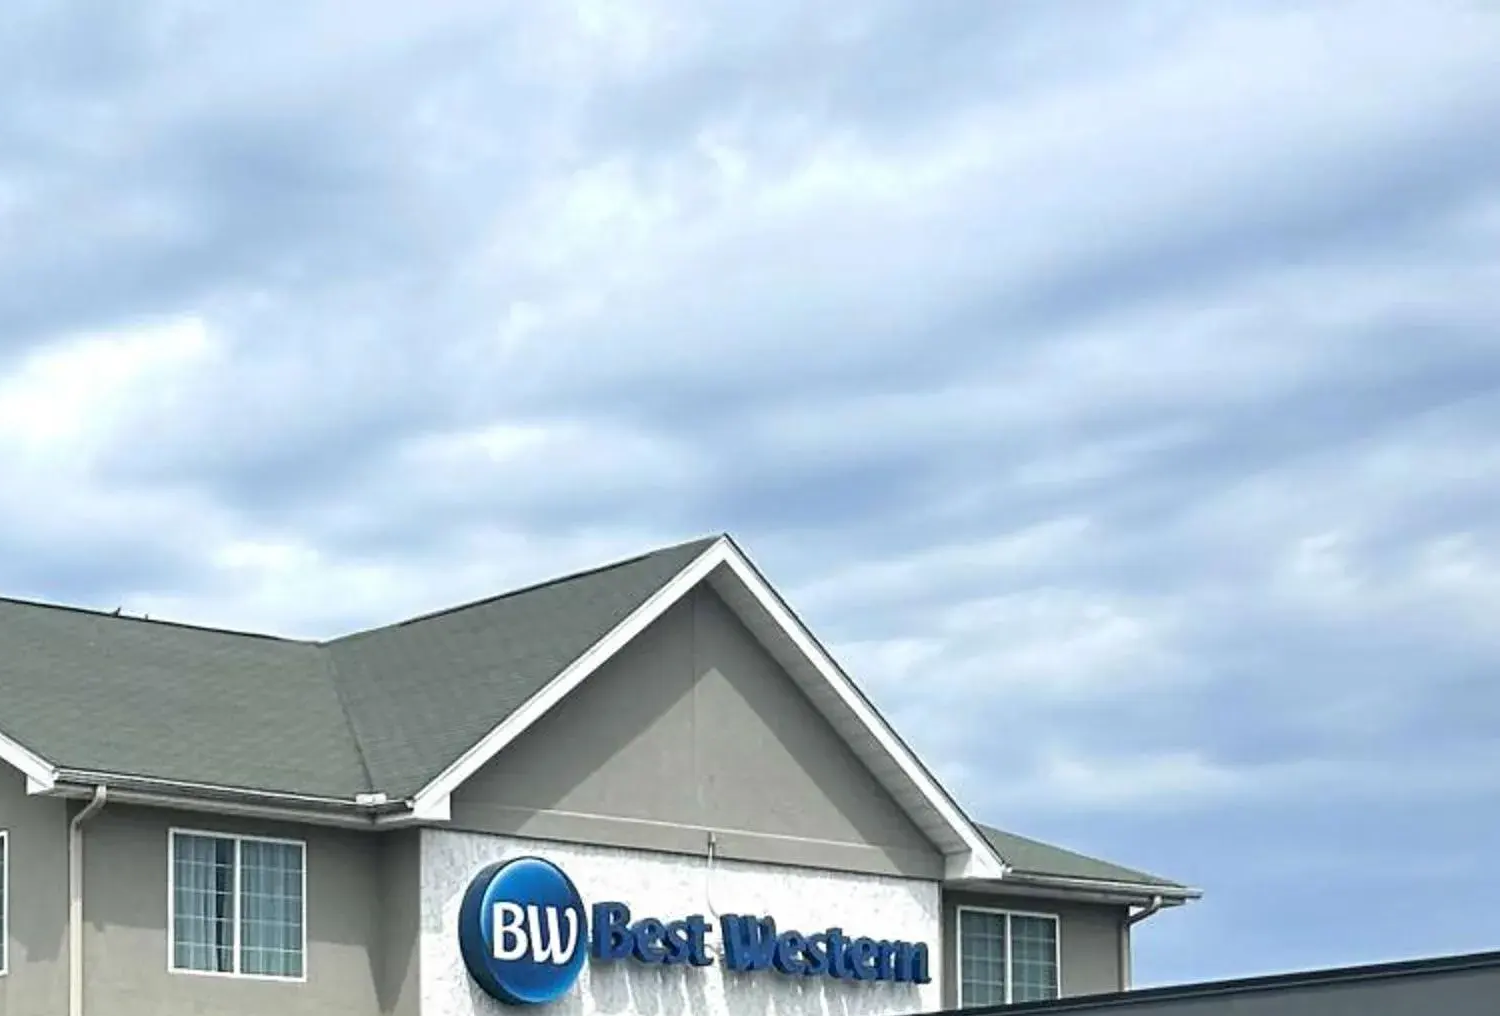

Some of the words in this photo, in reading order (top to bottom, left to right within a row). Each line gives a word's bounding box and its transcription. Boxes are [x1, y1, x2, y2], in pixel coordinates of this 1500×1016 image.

[492, 901, 579, 964] BW
[591, 901, 713, 966] Best
[720, 912, 931, 984] Western
